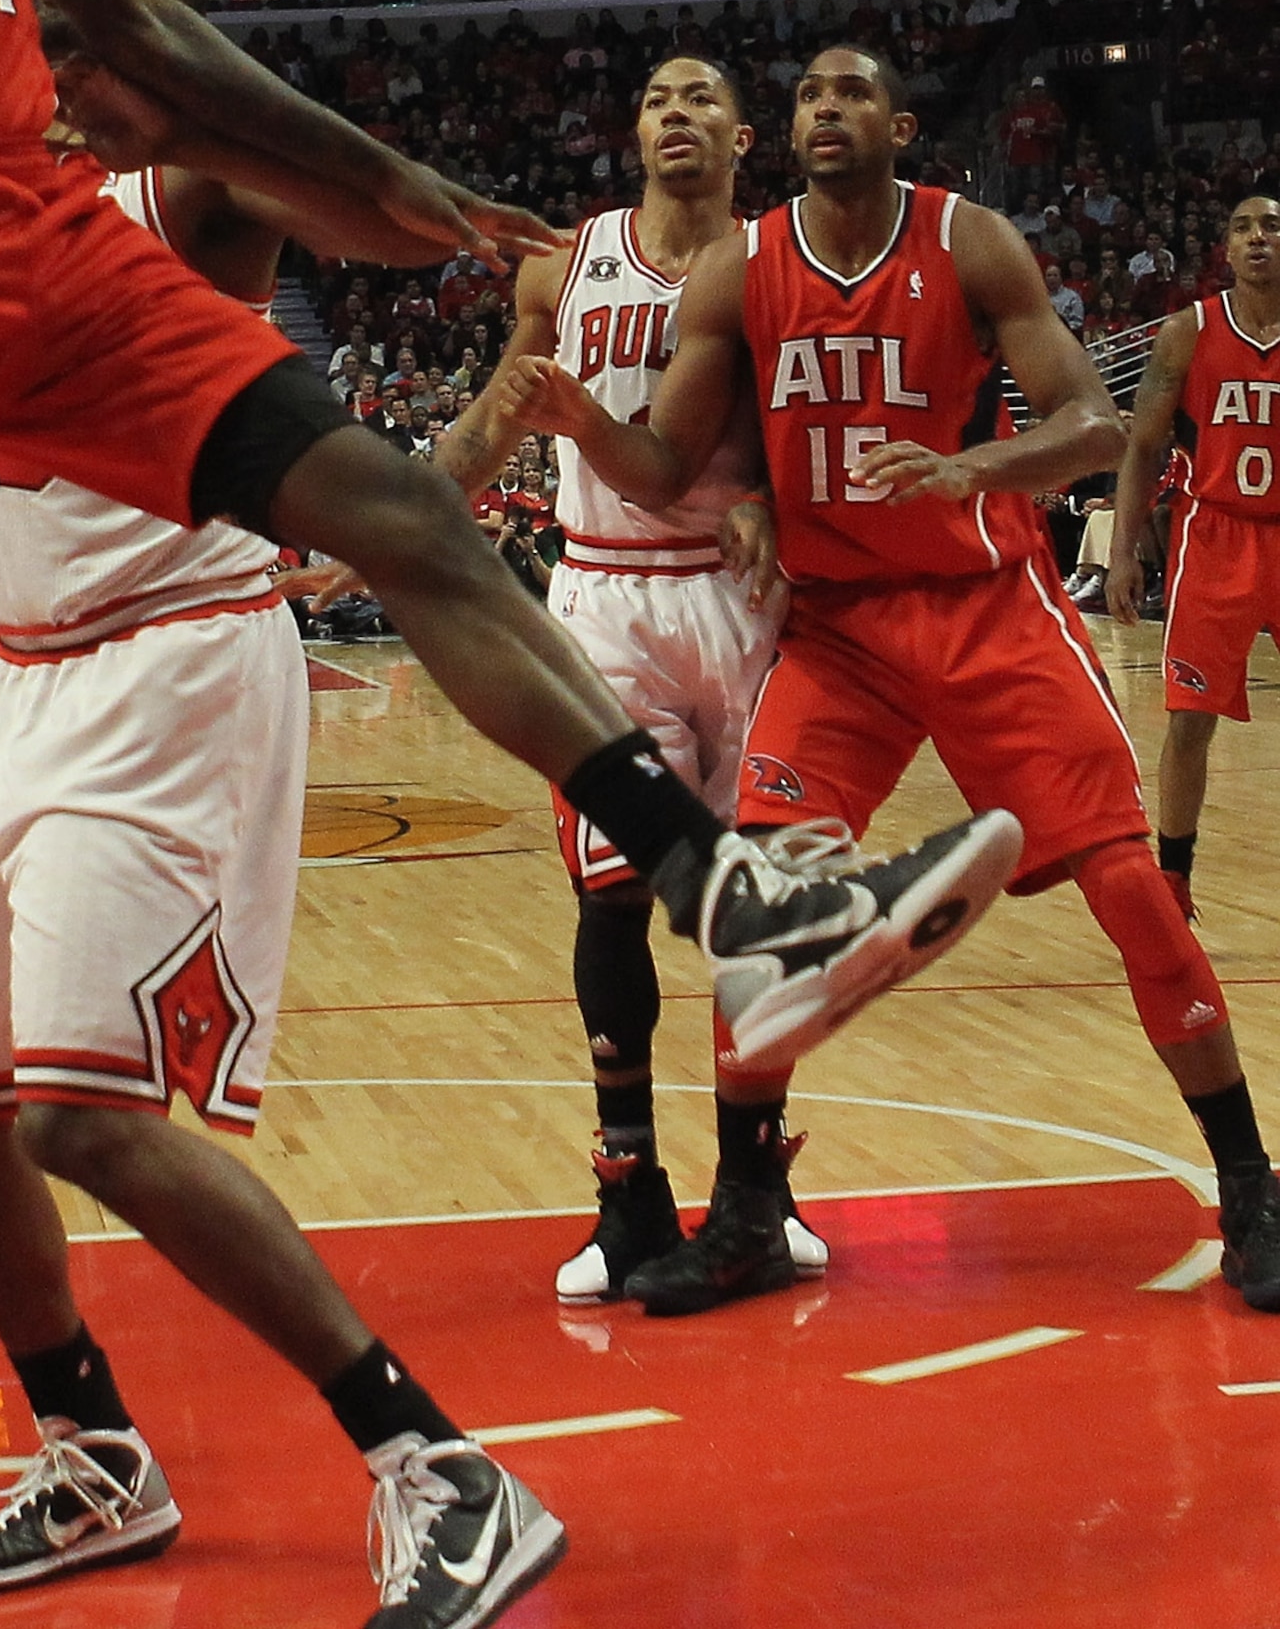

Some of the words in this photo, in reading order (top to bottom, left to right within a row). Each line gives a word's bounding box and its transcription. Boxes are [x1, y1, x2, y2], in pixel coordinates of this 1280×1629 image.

[770, 335, 929, 411] ATL
[1210, 380, 1280, 426] AT
[1236, 445, 1273, 497] 0
